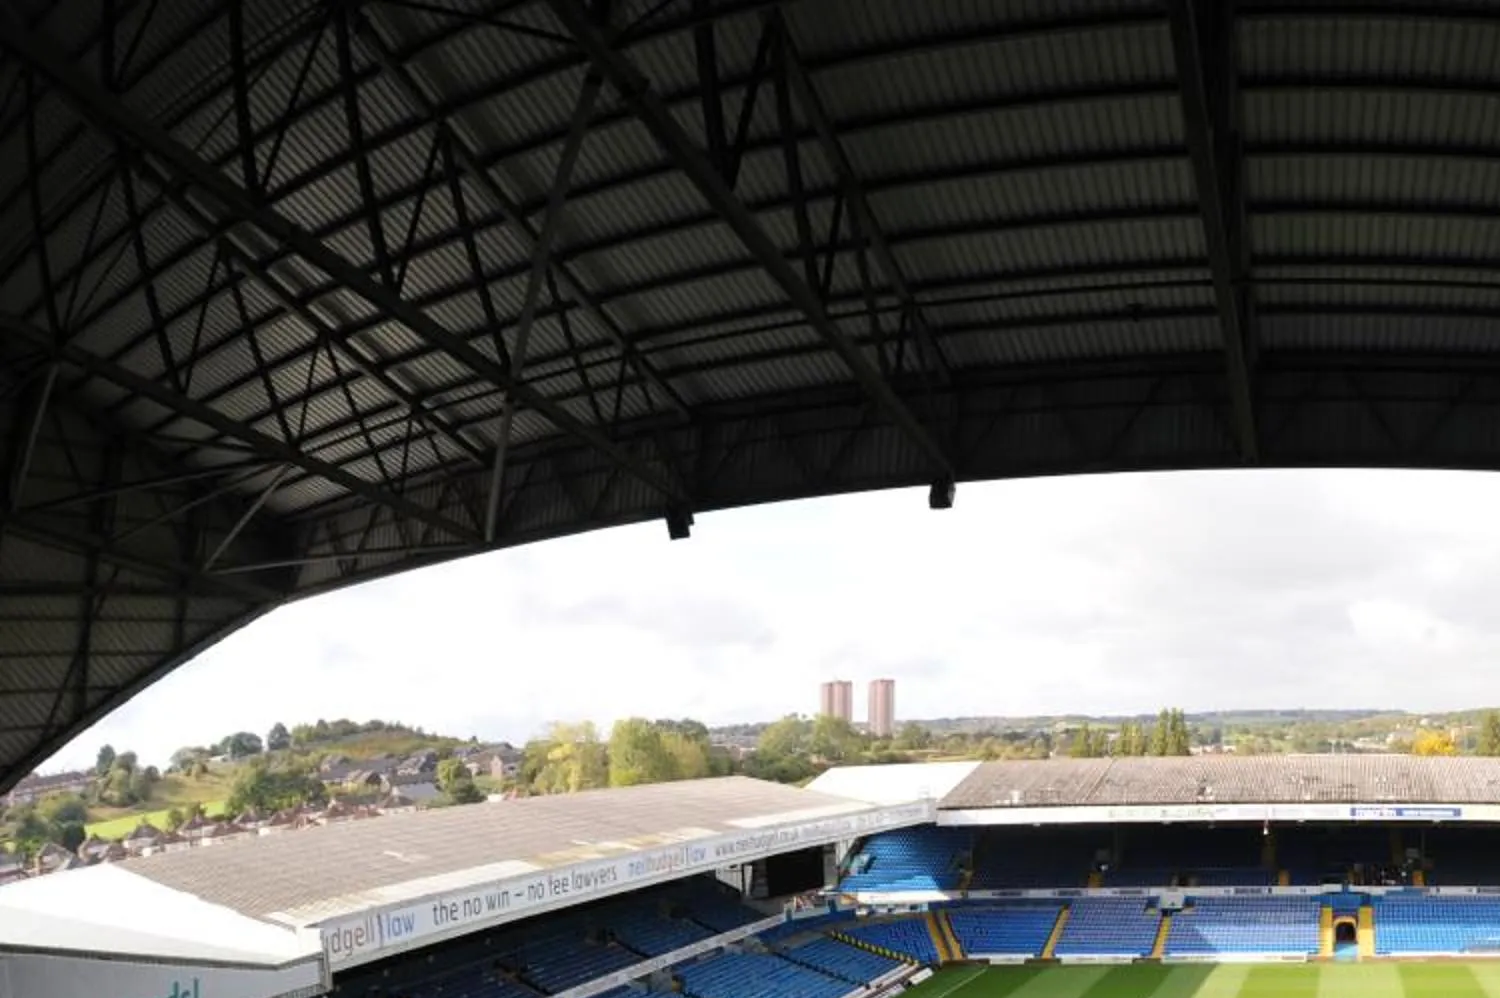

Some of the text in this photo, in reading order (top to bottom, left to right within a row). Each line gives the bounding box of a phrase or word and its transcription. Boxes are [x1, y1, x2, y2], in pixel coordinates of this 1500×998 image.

[386, 911, 416, 939] law
[432, 902, 459, 926] the
[463, 896, 483, 917] no
[485, 890, 511, 915] win
[527, 880, 546, 901] no
[548, 871, 570, 894] fee
[571, 863, 618, 890] lawyers
